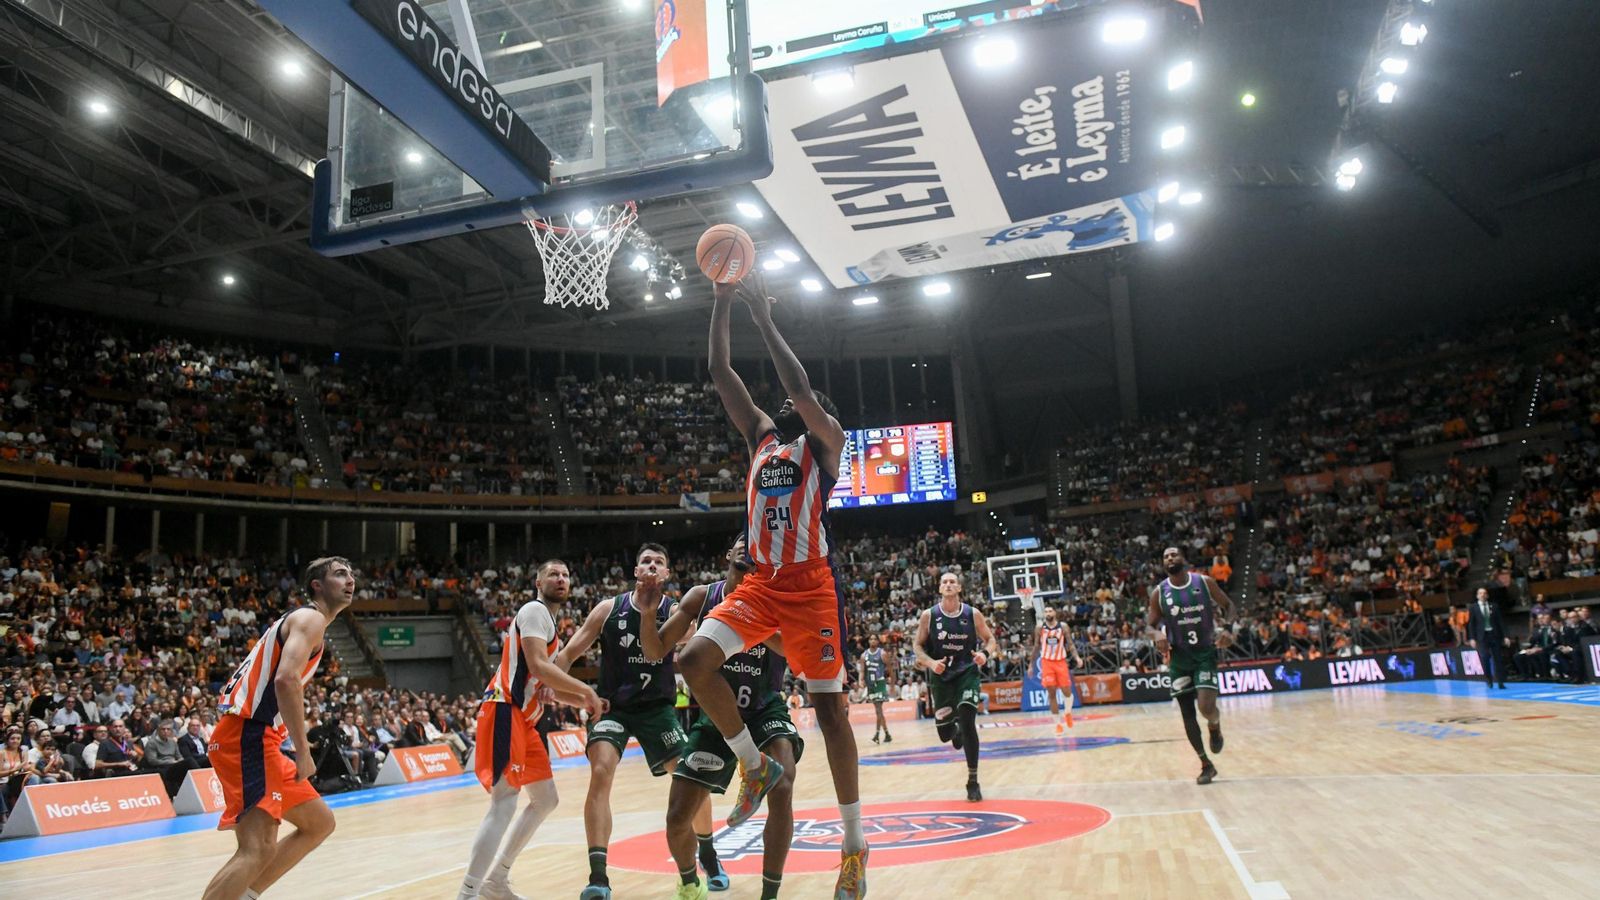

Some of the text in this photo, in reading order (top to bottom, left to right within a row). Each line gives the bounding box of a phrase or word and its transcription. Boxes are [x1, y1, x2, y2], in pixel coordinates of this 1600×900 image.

[928, 10, 956, 23] Unicaja
[833, 29, 857, 42] Leyma
[397, 1, 513, 139] endesa
[1115, 69, 1130, 96] 1962
[1006, 86, 1061, 181] É leite,
[1066, 75, 1115, 168] Leyma
[791, 84, 955, 231] LEYMA
[761, 465, 794, 478] Estrella
[761, 475, 793, 488] Galicia
[765, 506, 794, 531] 24
[1188, 630, 1199, 645] 3
[723, 661, 761, 676] málaga
[1328, 658, 1385, 685] LEYMA
[640, 673, 652, 690] 7
[1125, 674, 1172, 691] ende
[1217, 668, 1273, 694] LEYMA
[737, 685, 752, 708] 6
[45, 790, 161, 819] Nordés ancín
